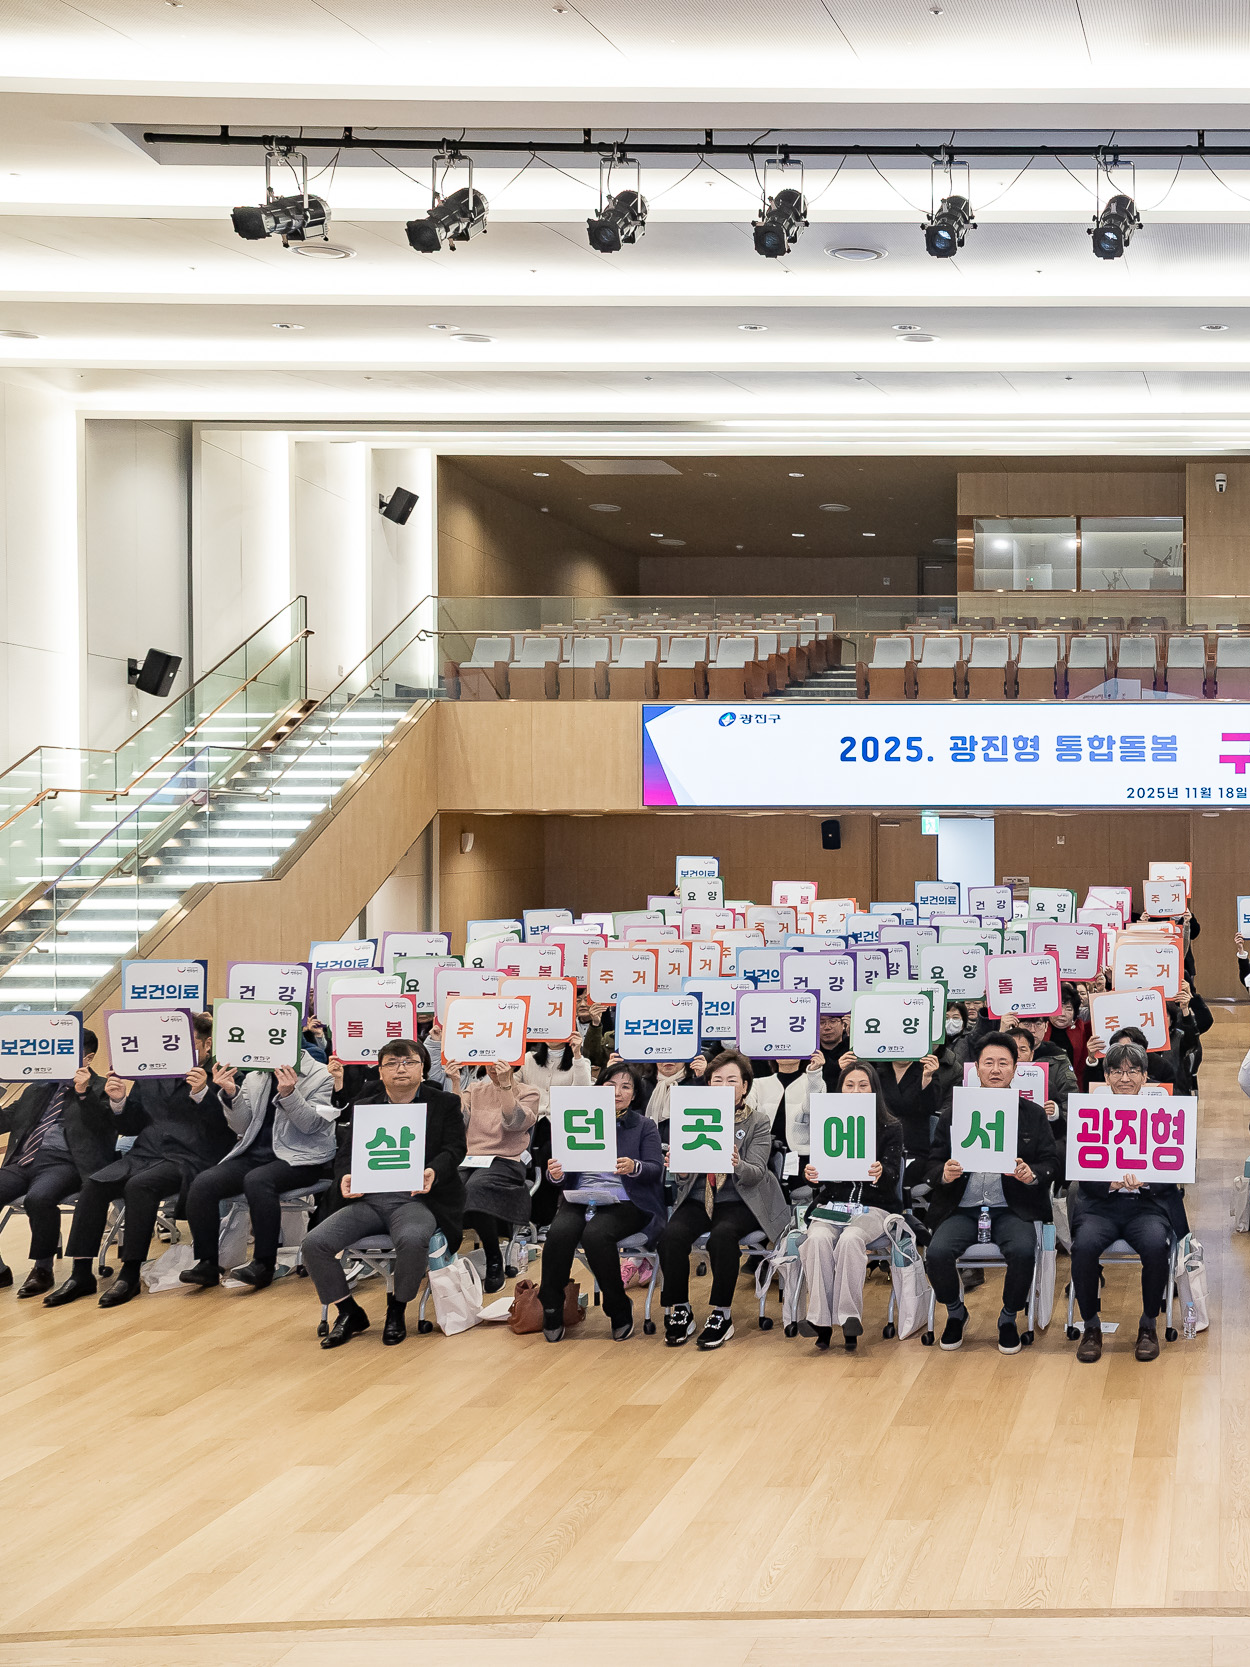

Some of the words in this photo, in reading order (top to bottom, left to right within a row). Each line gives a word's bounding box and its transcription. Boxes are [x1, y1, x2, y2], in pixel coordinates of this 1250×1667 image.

[740, 714, 780, 724] 광진구
[840, 736, 933, 762] 2025.
[950, 735, 1039, 762] 광진형
[1056, 735, 1178, 762] 통합돌봄
[1127, 787, 1178, 798] 2025년
[1185, 787, 1211, 798] 11월
[1219, 787, 1246, 798] 18일
[920, 896, 956, 905] 보건의료
[530, 925, 550, 936] 보건
[852, 931, 879, 942] 보건
[744, 970, 780, 982] 보건의
[131, 985, 199, 999] 보건의료
[624, 1019, 693, 1035] 보건의료
[1, 1039, 74, 1055] 보건의료
[564, 1108, 605, 1150] 던
[682, 1108, 723, 1150] 곳
[824, 1116, 865, 1158] 에
[961, 1110, 1004, 1152] 서
[1077, 1107, 1185, 1170] 광진형
[365, 1126, 415, 1170] 살
